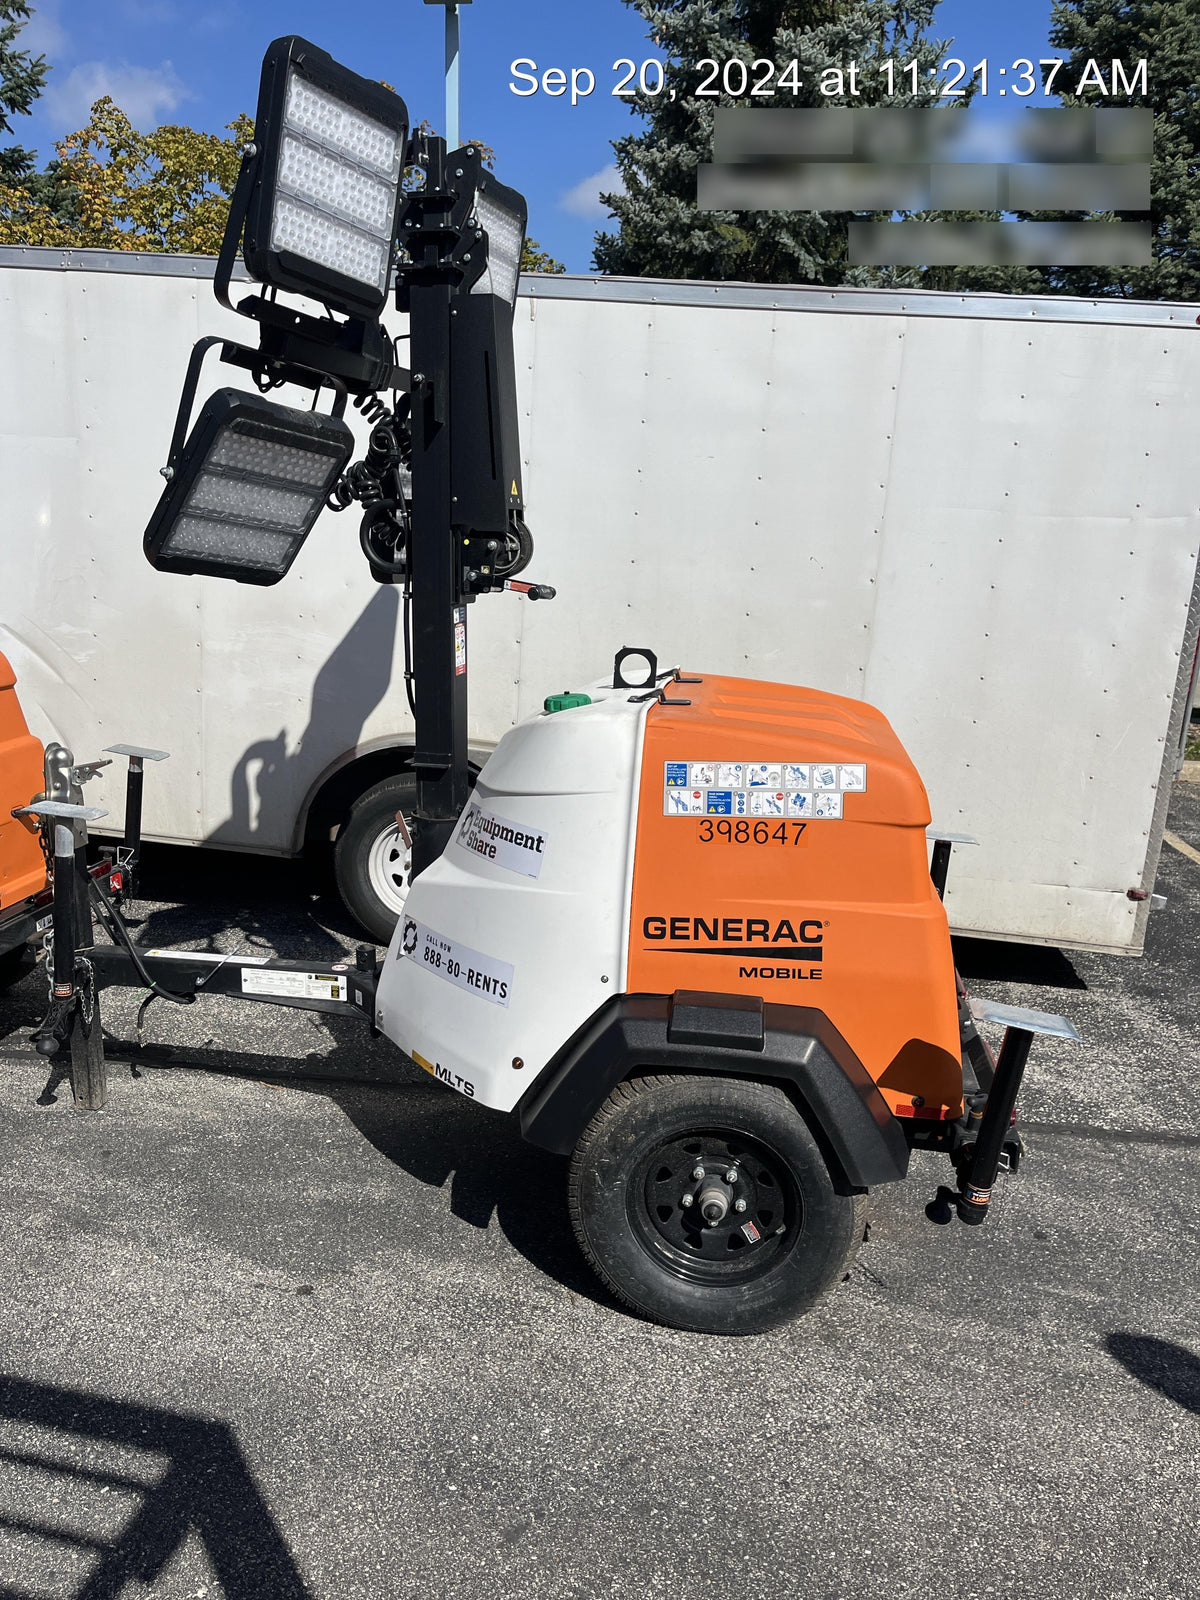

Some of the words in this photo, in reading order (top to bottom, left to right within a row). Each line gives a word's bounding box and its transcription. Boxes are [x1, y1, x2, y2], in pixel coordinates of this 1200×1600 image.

[466, 830, 497, 859] Share
[473, 810, 545, 853] Equipment
[698, 819, 807, 845] 398647
[426, 934, 438, 947] CALL
[440, 941, 452, 953] NOW
[643, 916, 823, 943] GENERAC
[423, 946, 508, 999] 888-80-RENTS
[739, 967, 823, 980] MOBILE
[435, 1062, 475, 1097] MLTS
